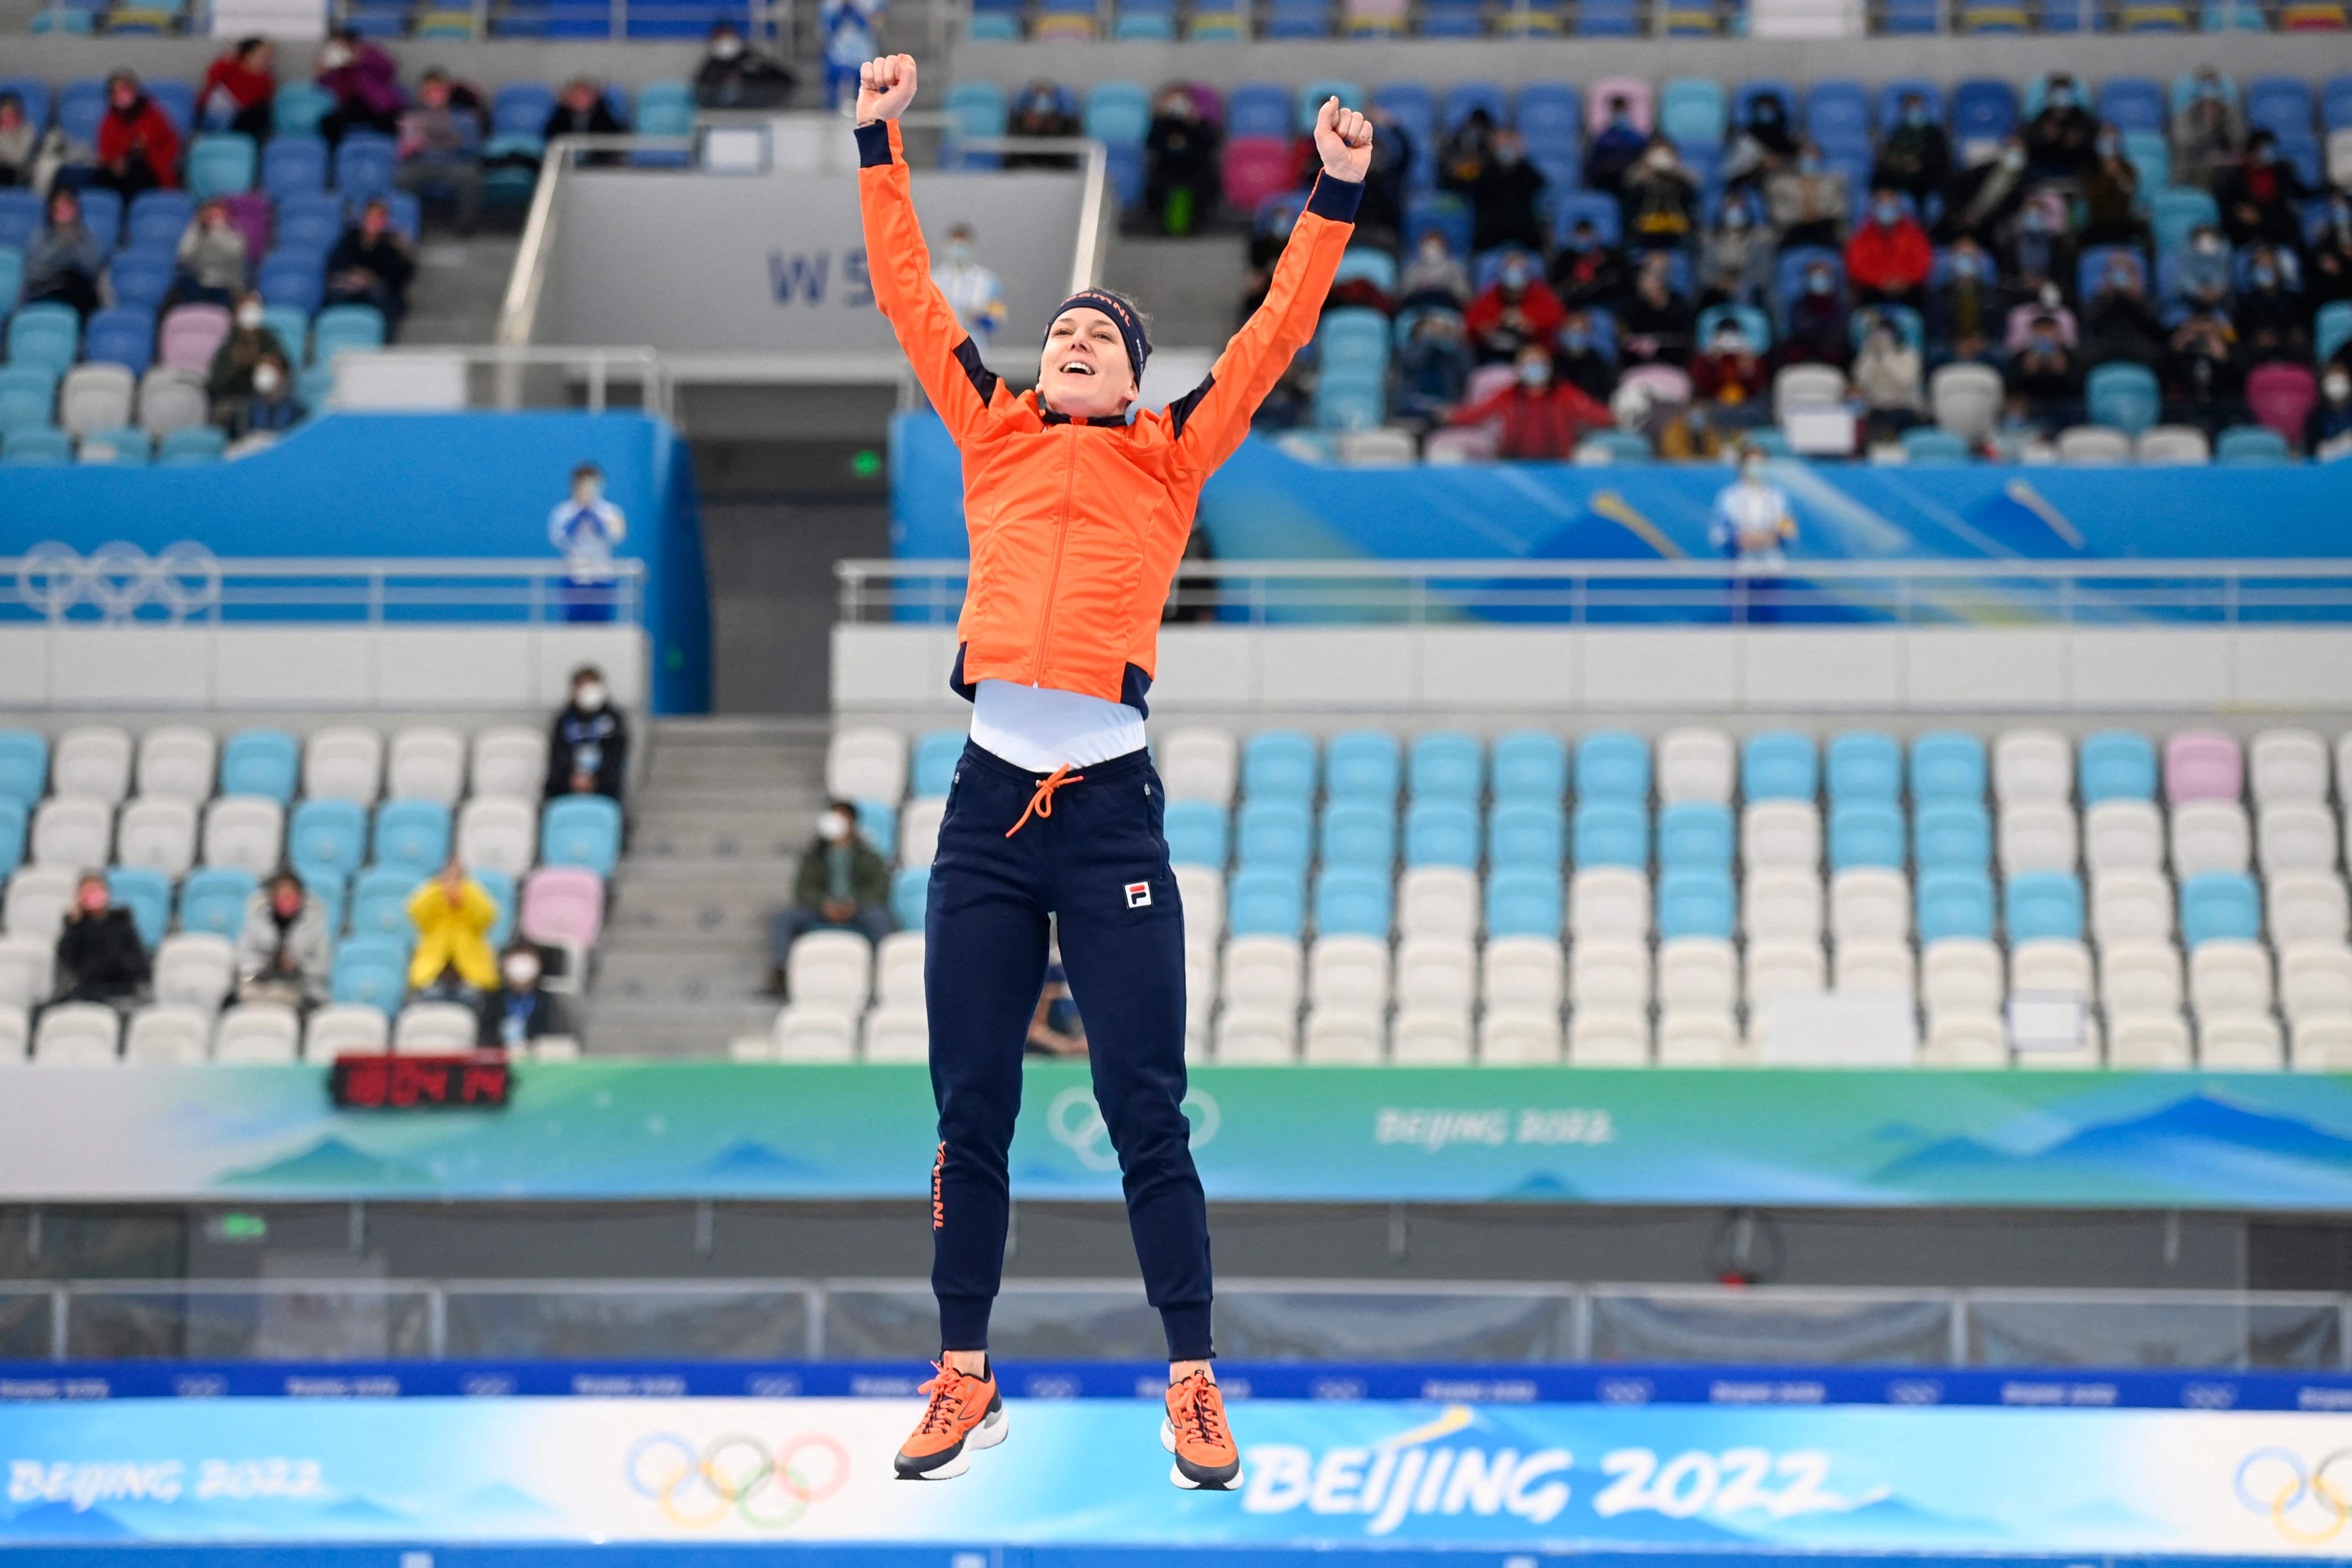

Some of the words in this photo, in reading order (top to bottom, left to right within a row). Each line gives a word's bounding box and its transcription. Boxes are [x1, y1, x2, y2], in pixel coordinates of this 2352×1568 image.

[7, 1459, 184, 1511] BEIJING
[196, 1457, 328, 1497] 2022
[1242, 1444, 1574, 1536] BEIJING
[1593, 1446, 1864, 1519] 2022
